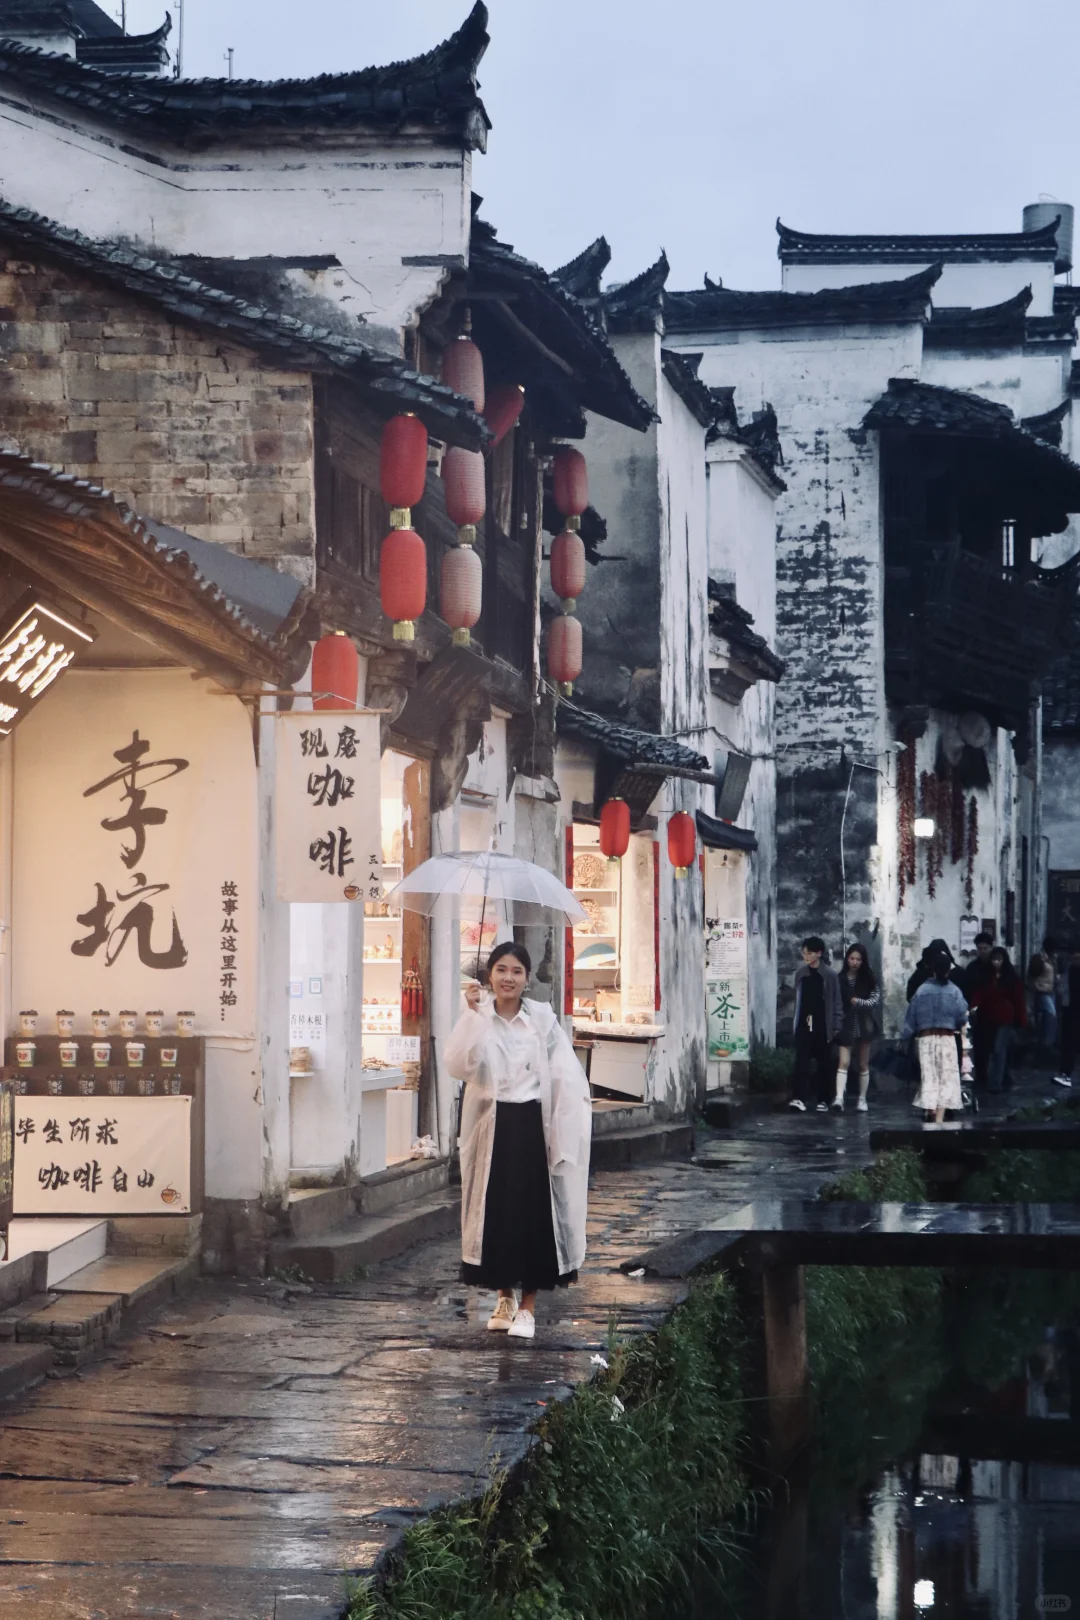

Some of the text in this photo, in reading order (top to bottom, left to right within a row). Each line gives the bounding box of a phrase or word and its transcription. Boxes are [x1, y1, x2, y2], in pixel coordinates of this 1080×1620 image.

[300, 725, 360, 758] 现磨
[307, 764, 355, 877] 咖啡
[711, 981, 741, 1042] 新茶上市
[16, 1117, 118, 1145] 毕生所求
[38, 1159, 155, 1194] 咖啡自由
